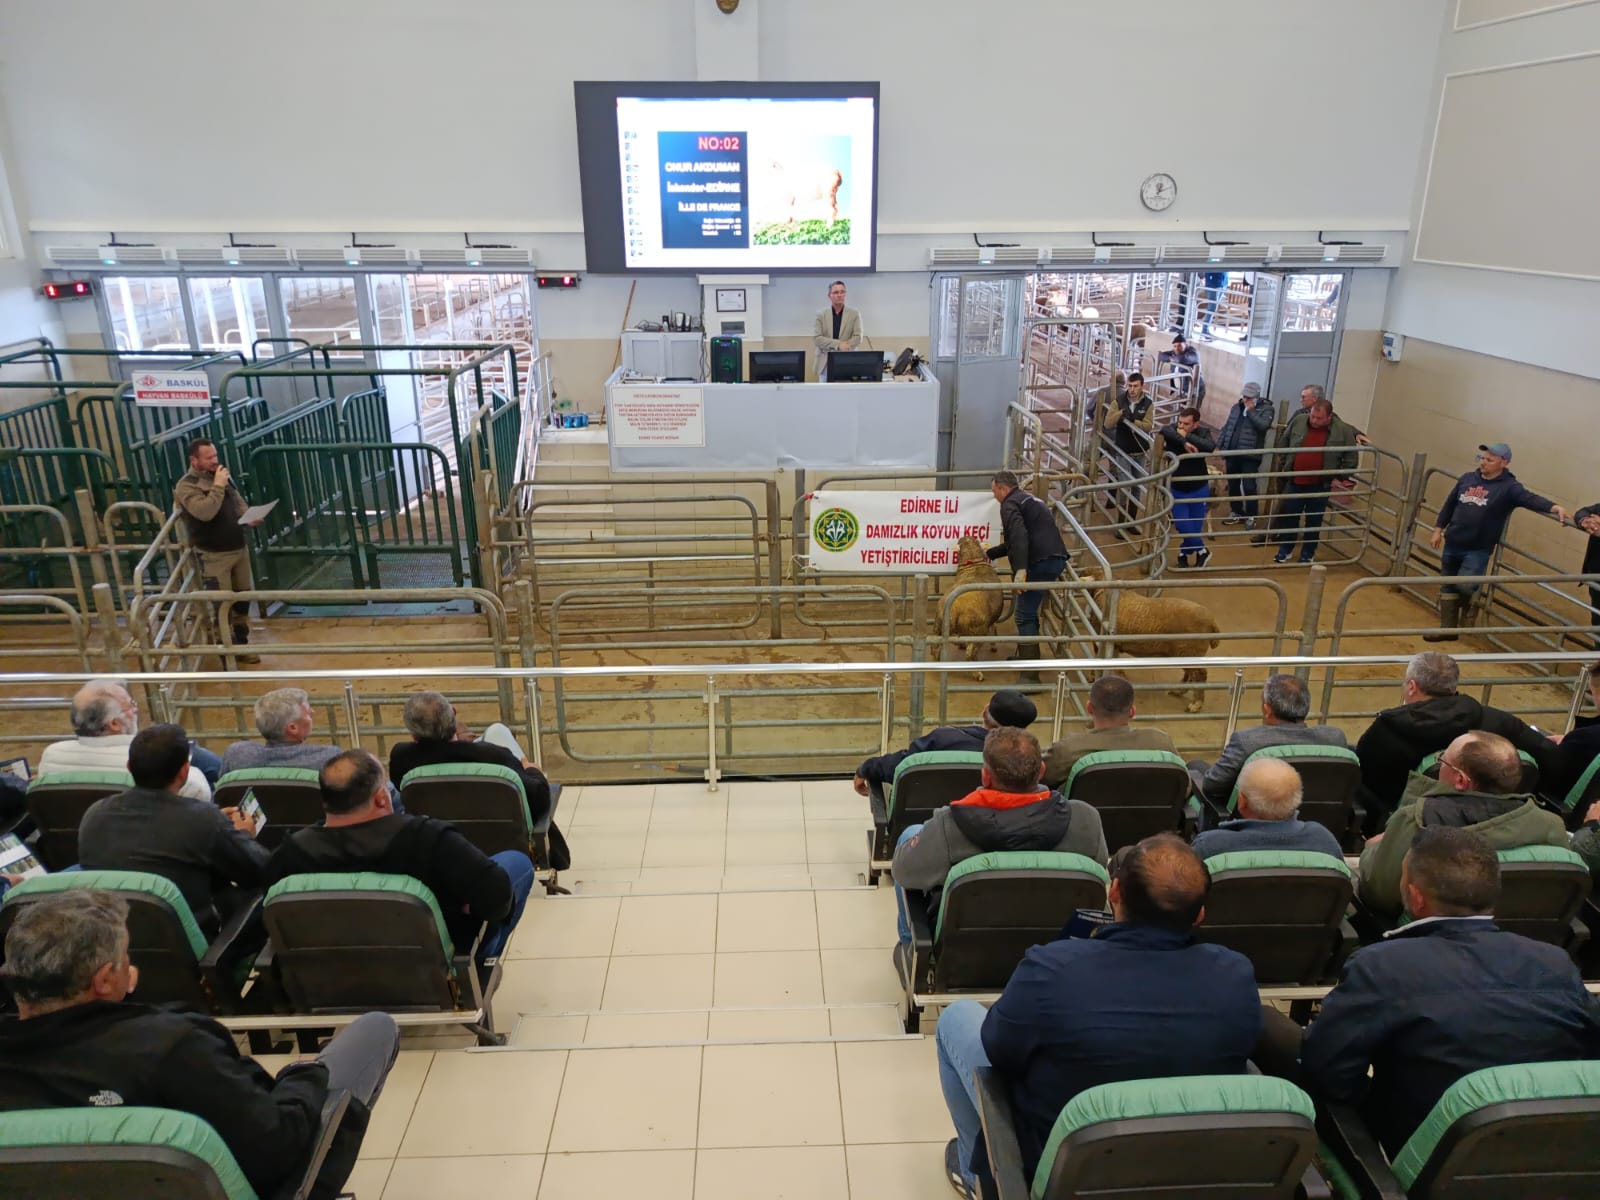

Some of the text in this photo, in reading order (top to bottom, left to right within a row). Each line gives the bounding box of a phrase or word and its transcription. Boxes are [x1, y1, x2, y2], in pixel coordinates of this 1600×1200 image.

[698, 136, 740, 151] NO:02
[665, 162, 741, 172] ONUR AKDUMAN
[697, 202, 708, 212] DE
[709, 202, 741, 212] FRANCE
[166, 378, 207, 387] BASKÜL
[170, 391, 204, 400] BASKÜLÜ
[900, 496, 959, 514] EDİRNE İLİ
[866, 522, 991, 542] DAMIZLIK KOYUN KEÇİ
[860, 546, 949, 567] YETİŞTİRİCİLERİ
